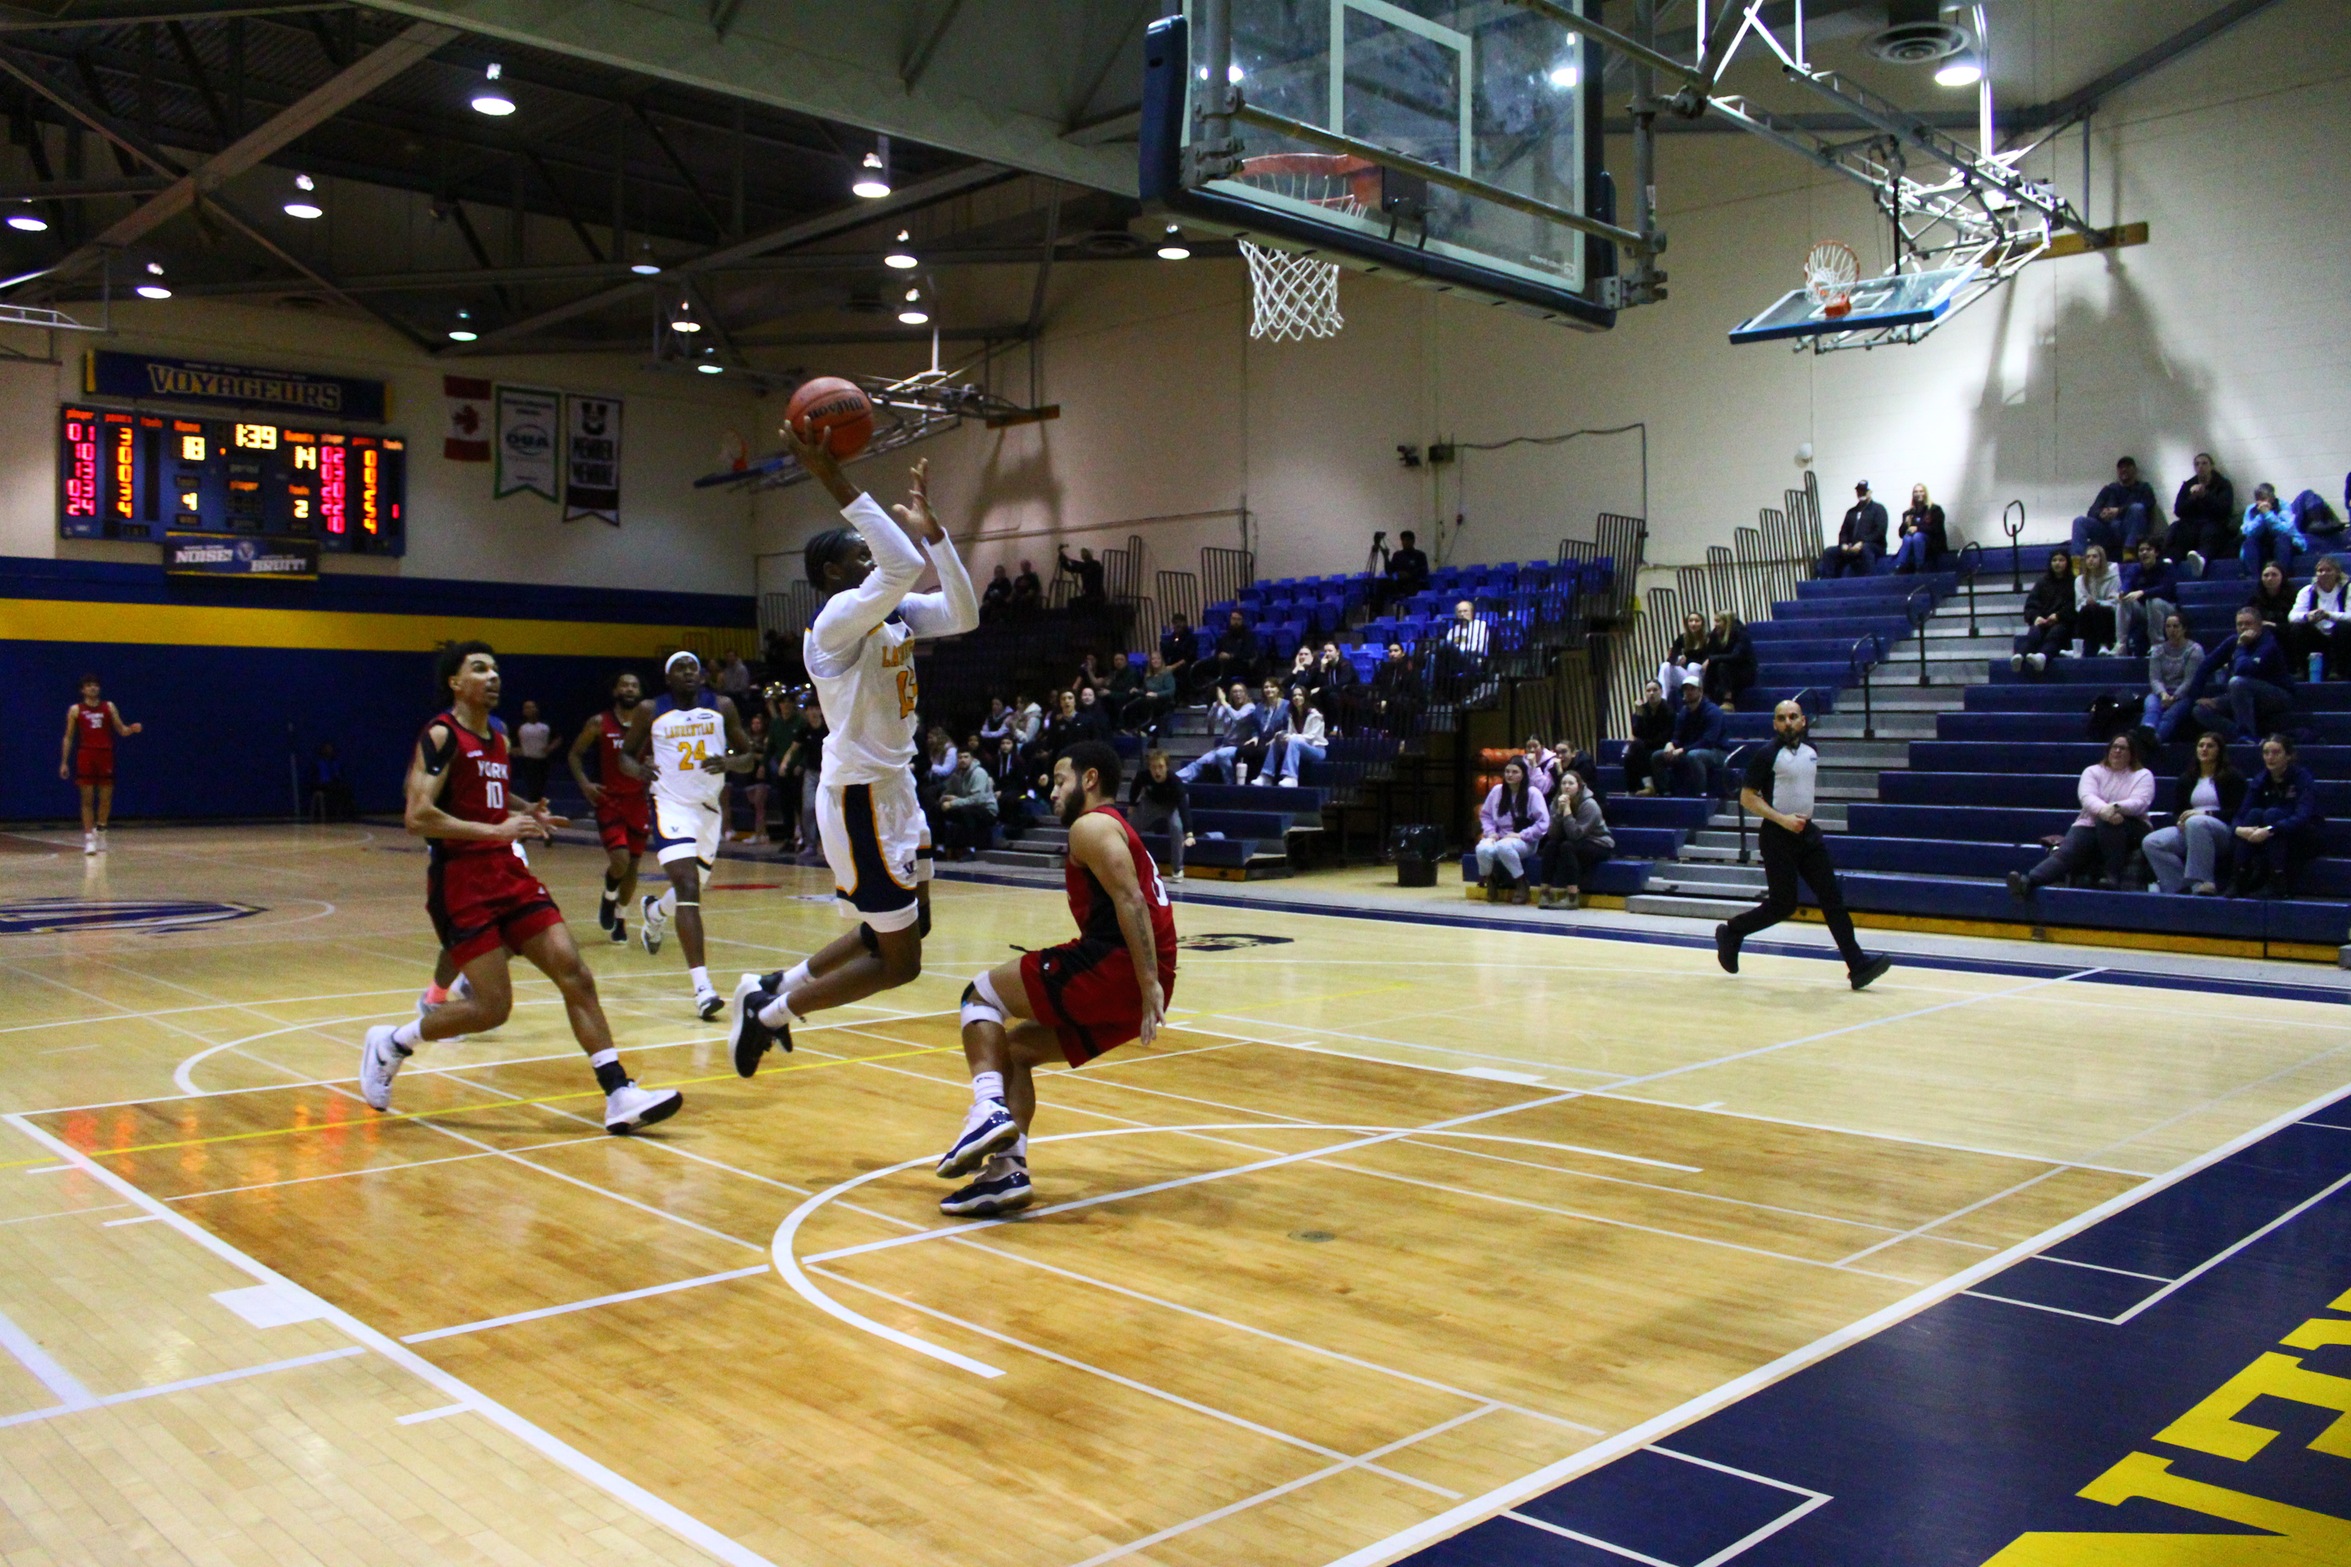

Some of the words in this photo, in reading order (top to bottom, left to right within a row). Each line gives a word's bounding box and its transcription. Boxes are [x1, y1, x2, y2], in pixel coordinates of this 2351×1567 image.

[146, 363, 343, 412] VOYAGEURS
[182, 435, 206, 461] 18
[235, 423, 277, 450] 1:39
[294, 445, 317, 470] 14
[293, 499, 309, 519] 2
[664, 722, 715, 739] LAURENTIAN
[678, 740, 708, 770] 24
[477, 760, 509, 780] YORK
[486, 781, 504, 809] 10
